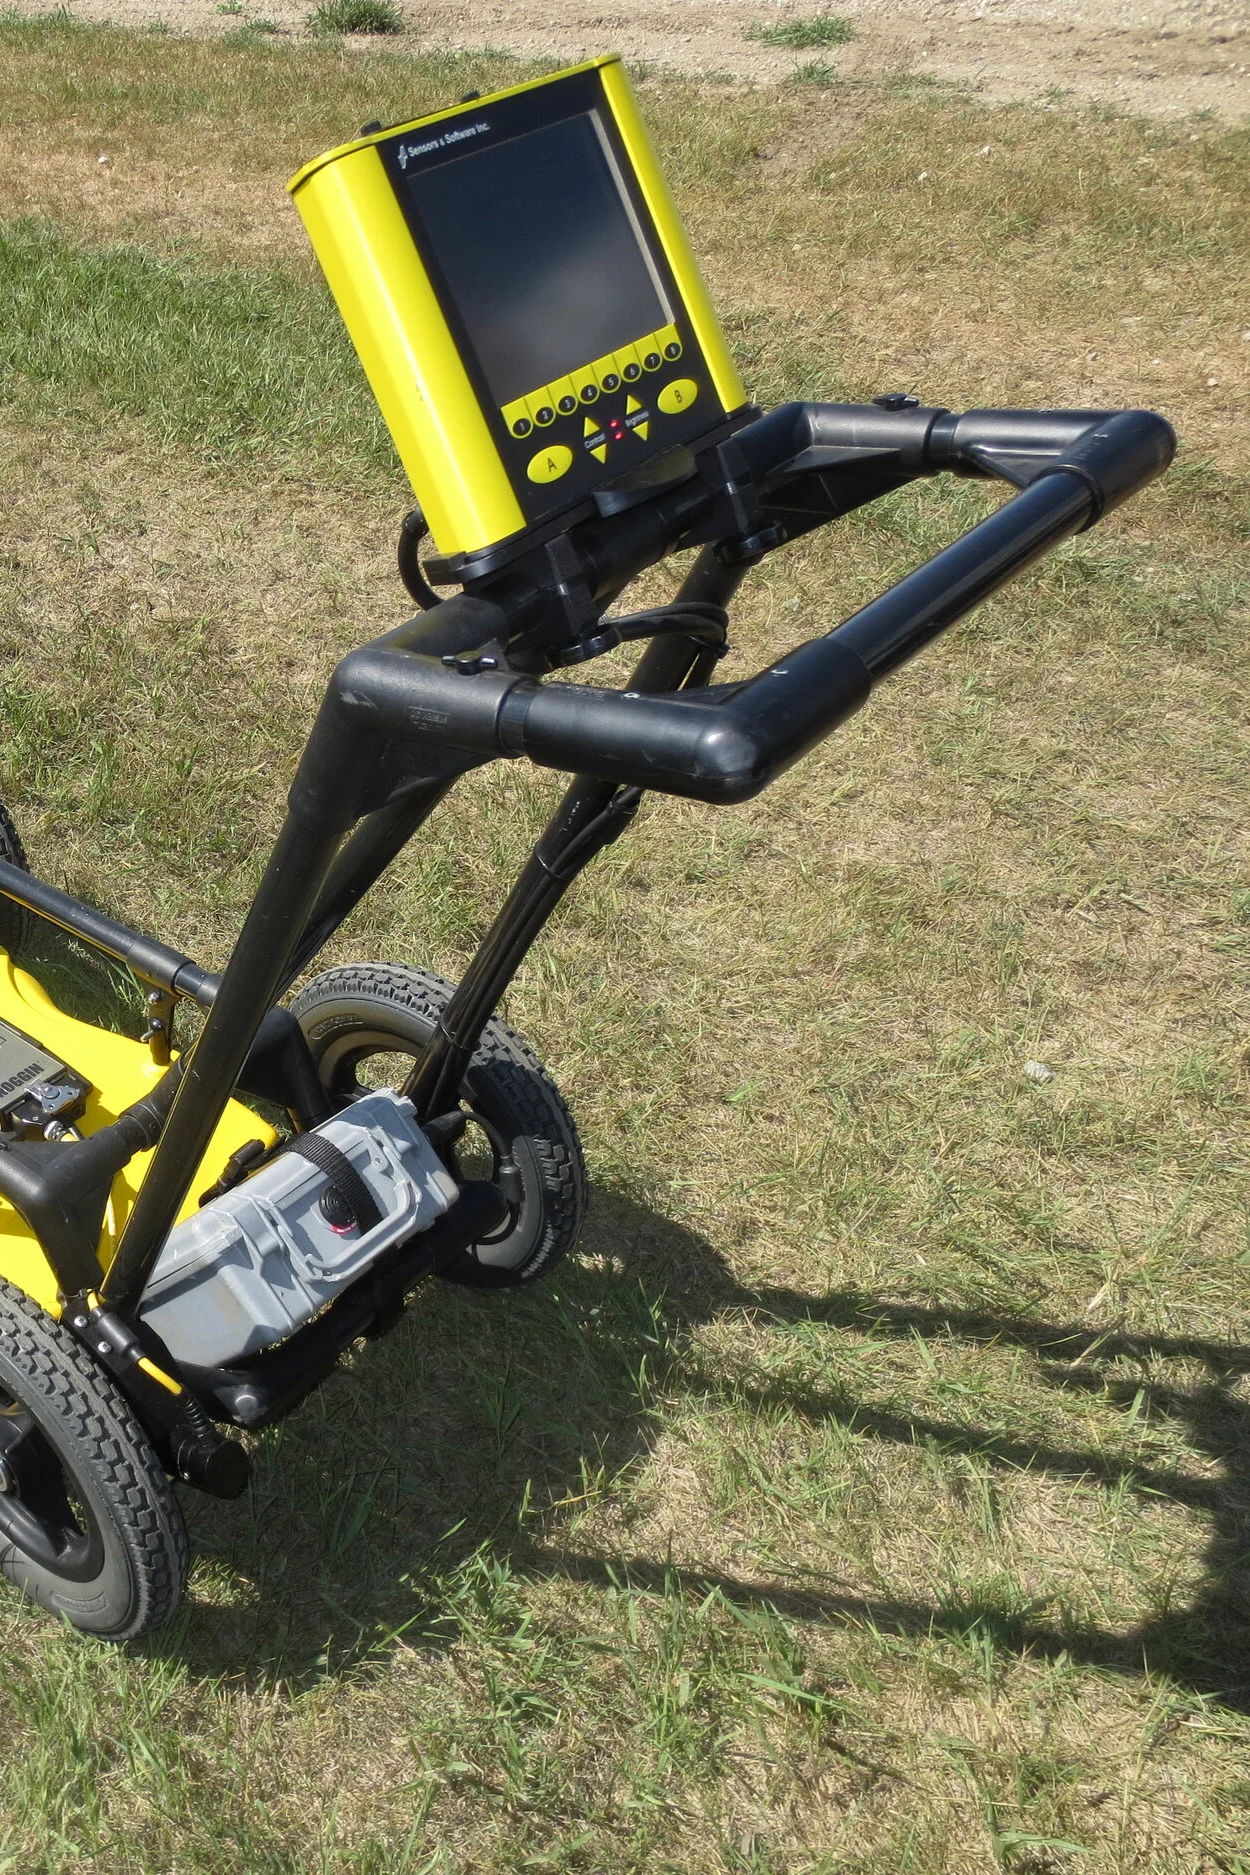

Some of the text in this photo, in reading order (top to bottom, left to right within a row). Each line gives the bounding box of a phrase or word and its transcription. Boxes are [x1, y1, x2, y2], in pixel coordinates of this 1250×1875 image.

[408, 140, 439, 157] Sensors
[444, 126, 476, 144] Software
[475, 123, 490, 133] Inc.
[519, 422, 525, 431] 1
[542, 410, 549, 420] 2
[565, 399, 571, 408] 3
[587, 388, 593, 396] 4
[608, 377, 614, 387] 5
[630, 367, 636, 376] 6
[650, 356, 655, 365] 7
[674, 390, 683, 403] B
[547, 457, 557, 473] A
